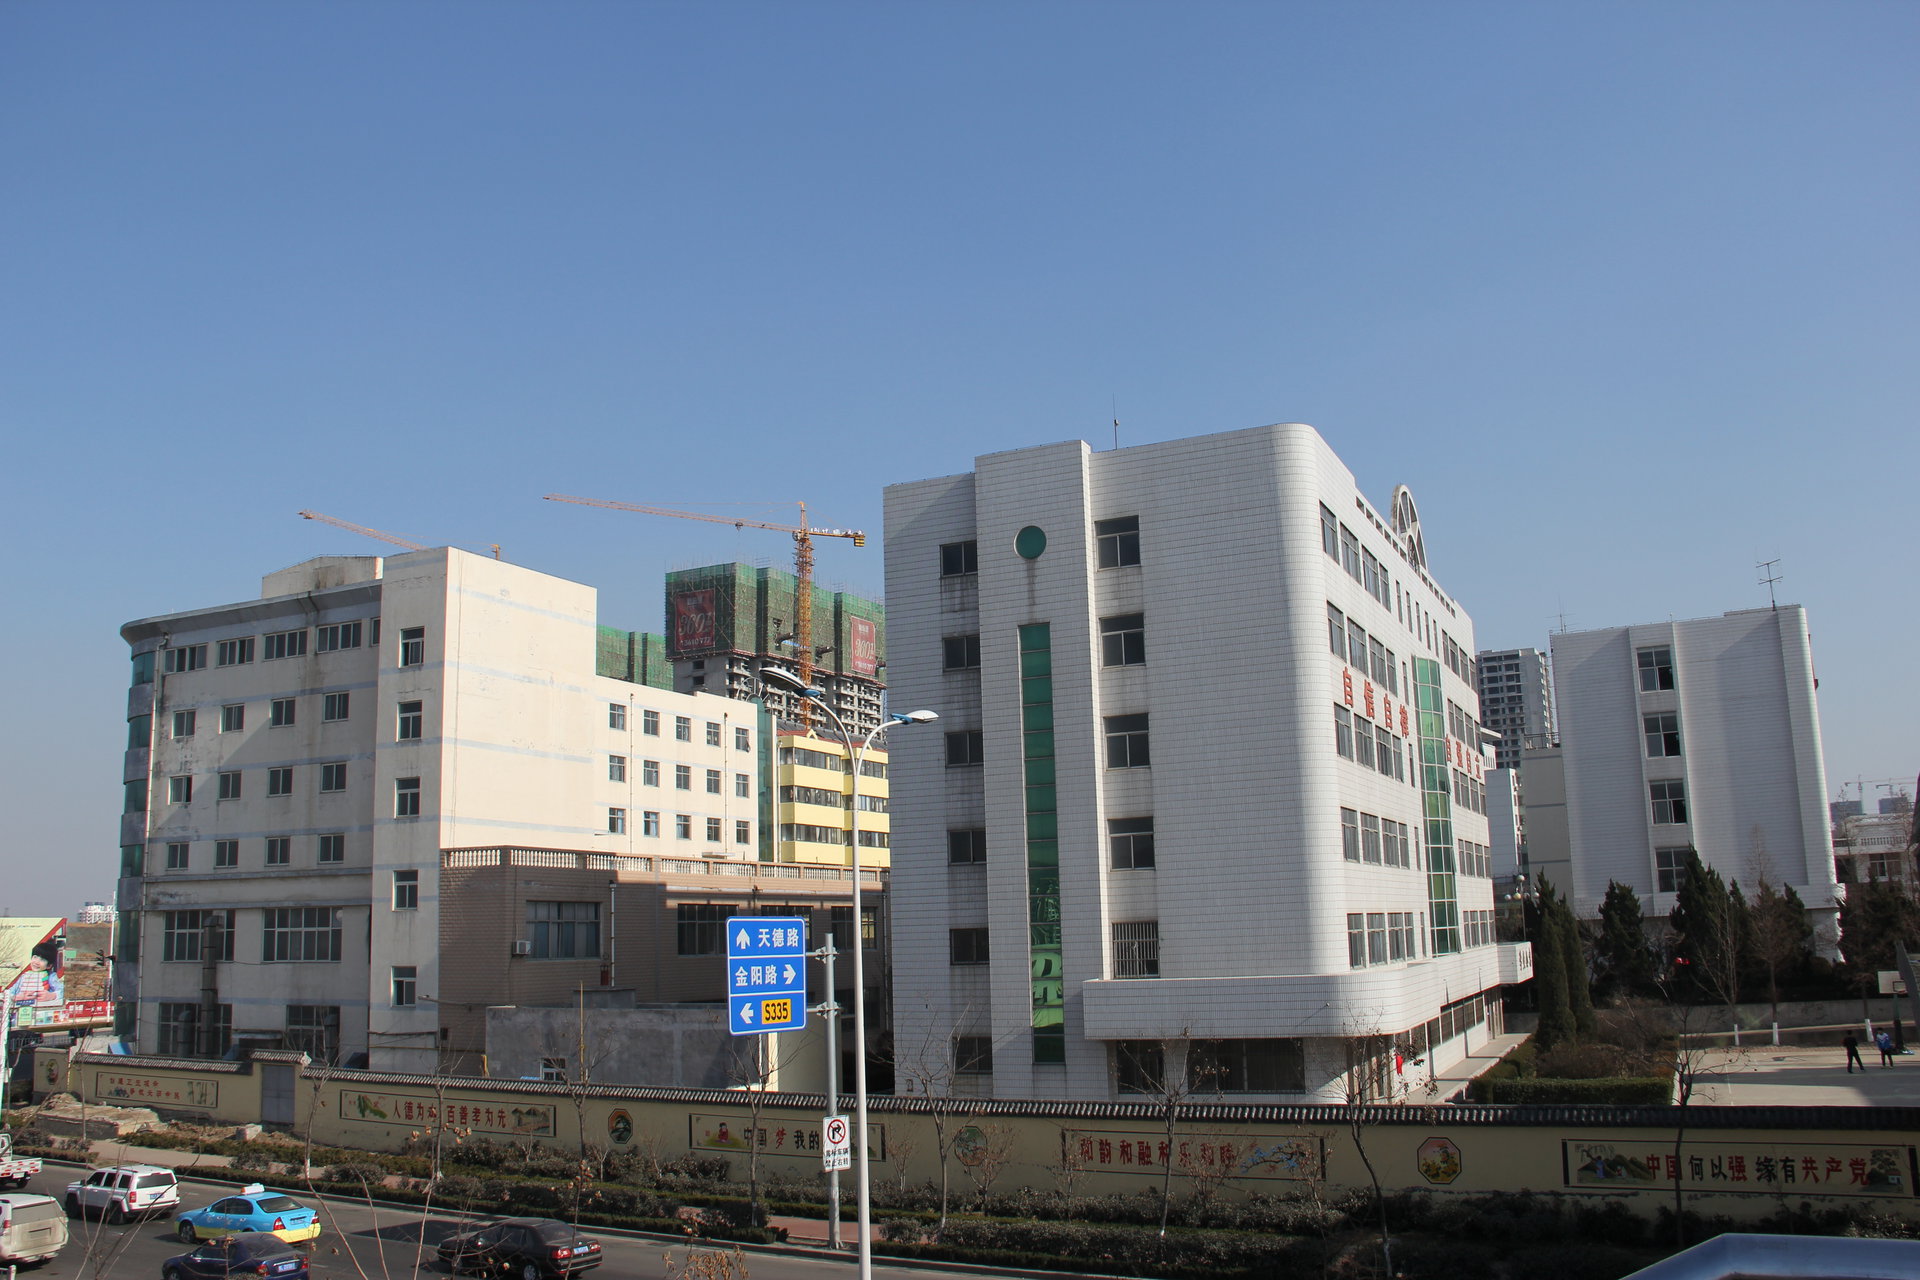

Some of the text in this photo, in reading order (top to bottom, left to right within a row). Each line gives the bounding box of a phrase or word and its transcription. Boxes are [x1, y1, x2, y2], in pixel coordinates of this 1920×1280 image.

[758, 927, 799, 948] 天德路
[735, 964, 778, 987] 金阳路
[764, 1001, 789, 1021] S335
